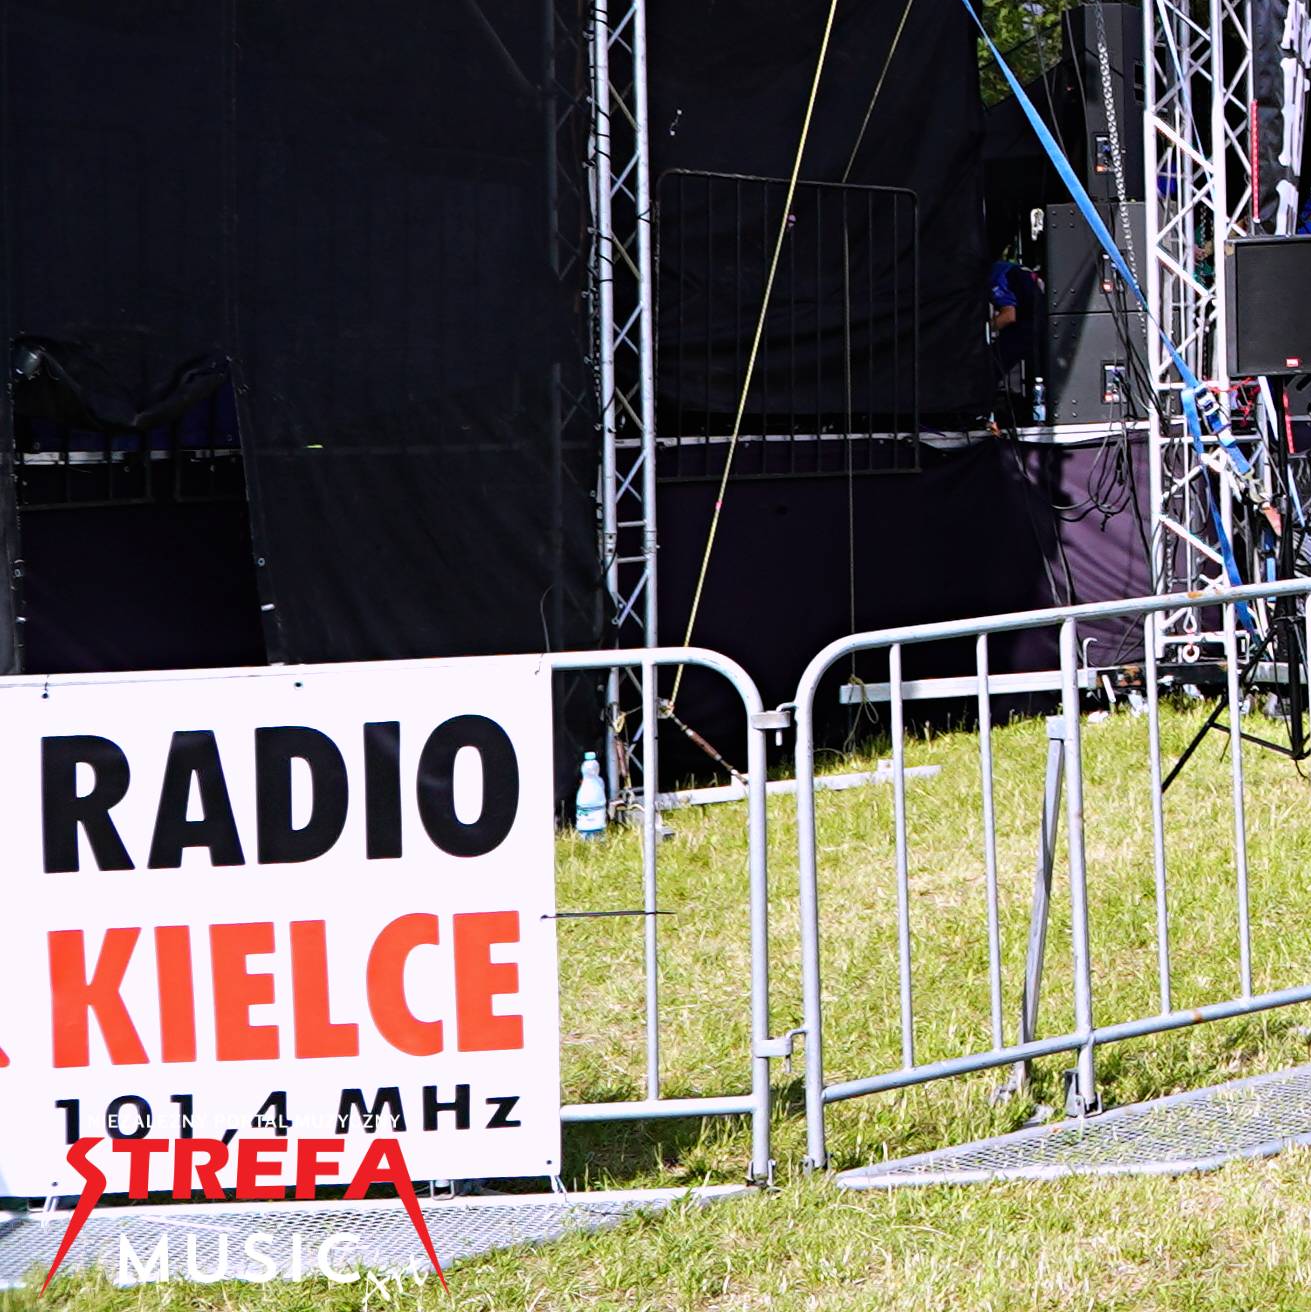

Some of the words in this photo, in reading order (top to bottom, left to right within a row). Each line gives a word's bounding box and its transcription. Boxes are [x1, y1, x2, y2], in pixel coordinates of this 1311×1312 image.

[41, 714, 520, 874] RADIO
[47, 911, 525, 1068] KIELCE
[54, 1091, 292, 1147] 101,4
[334, 1083, 522, 1134] MHz
